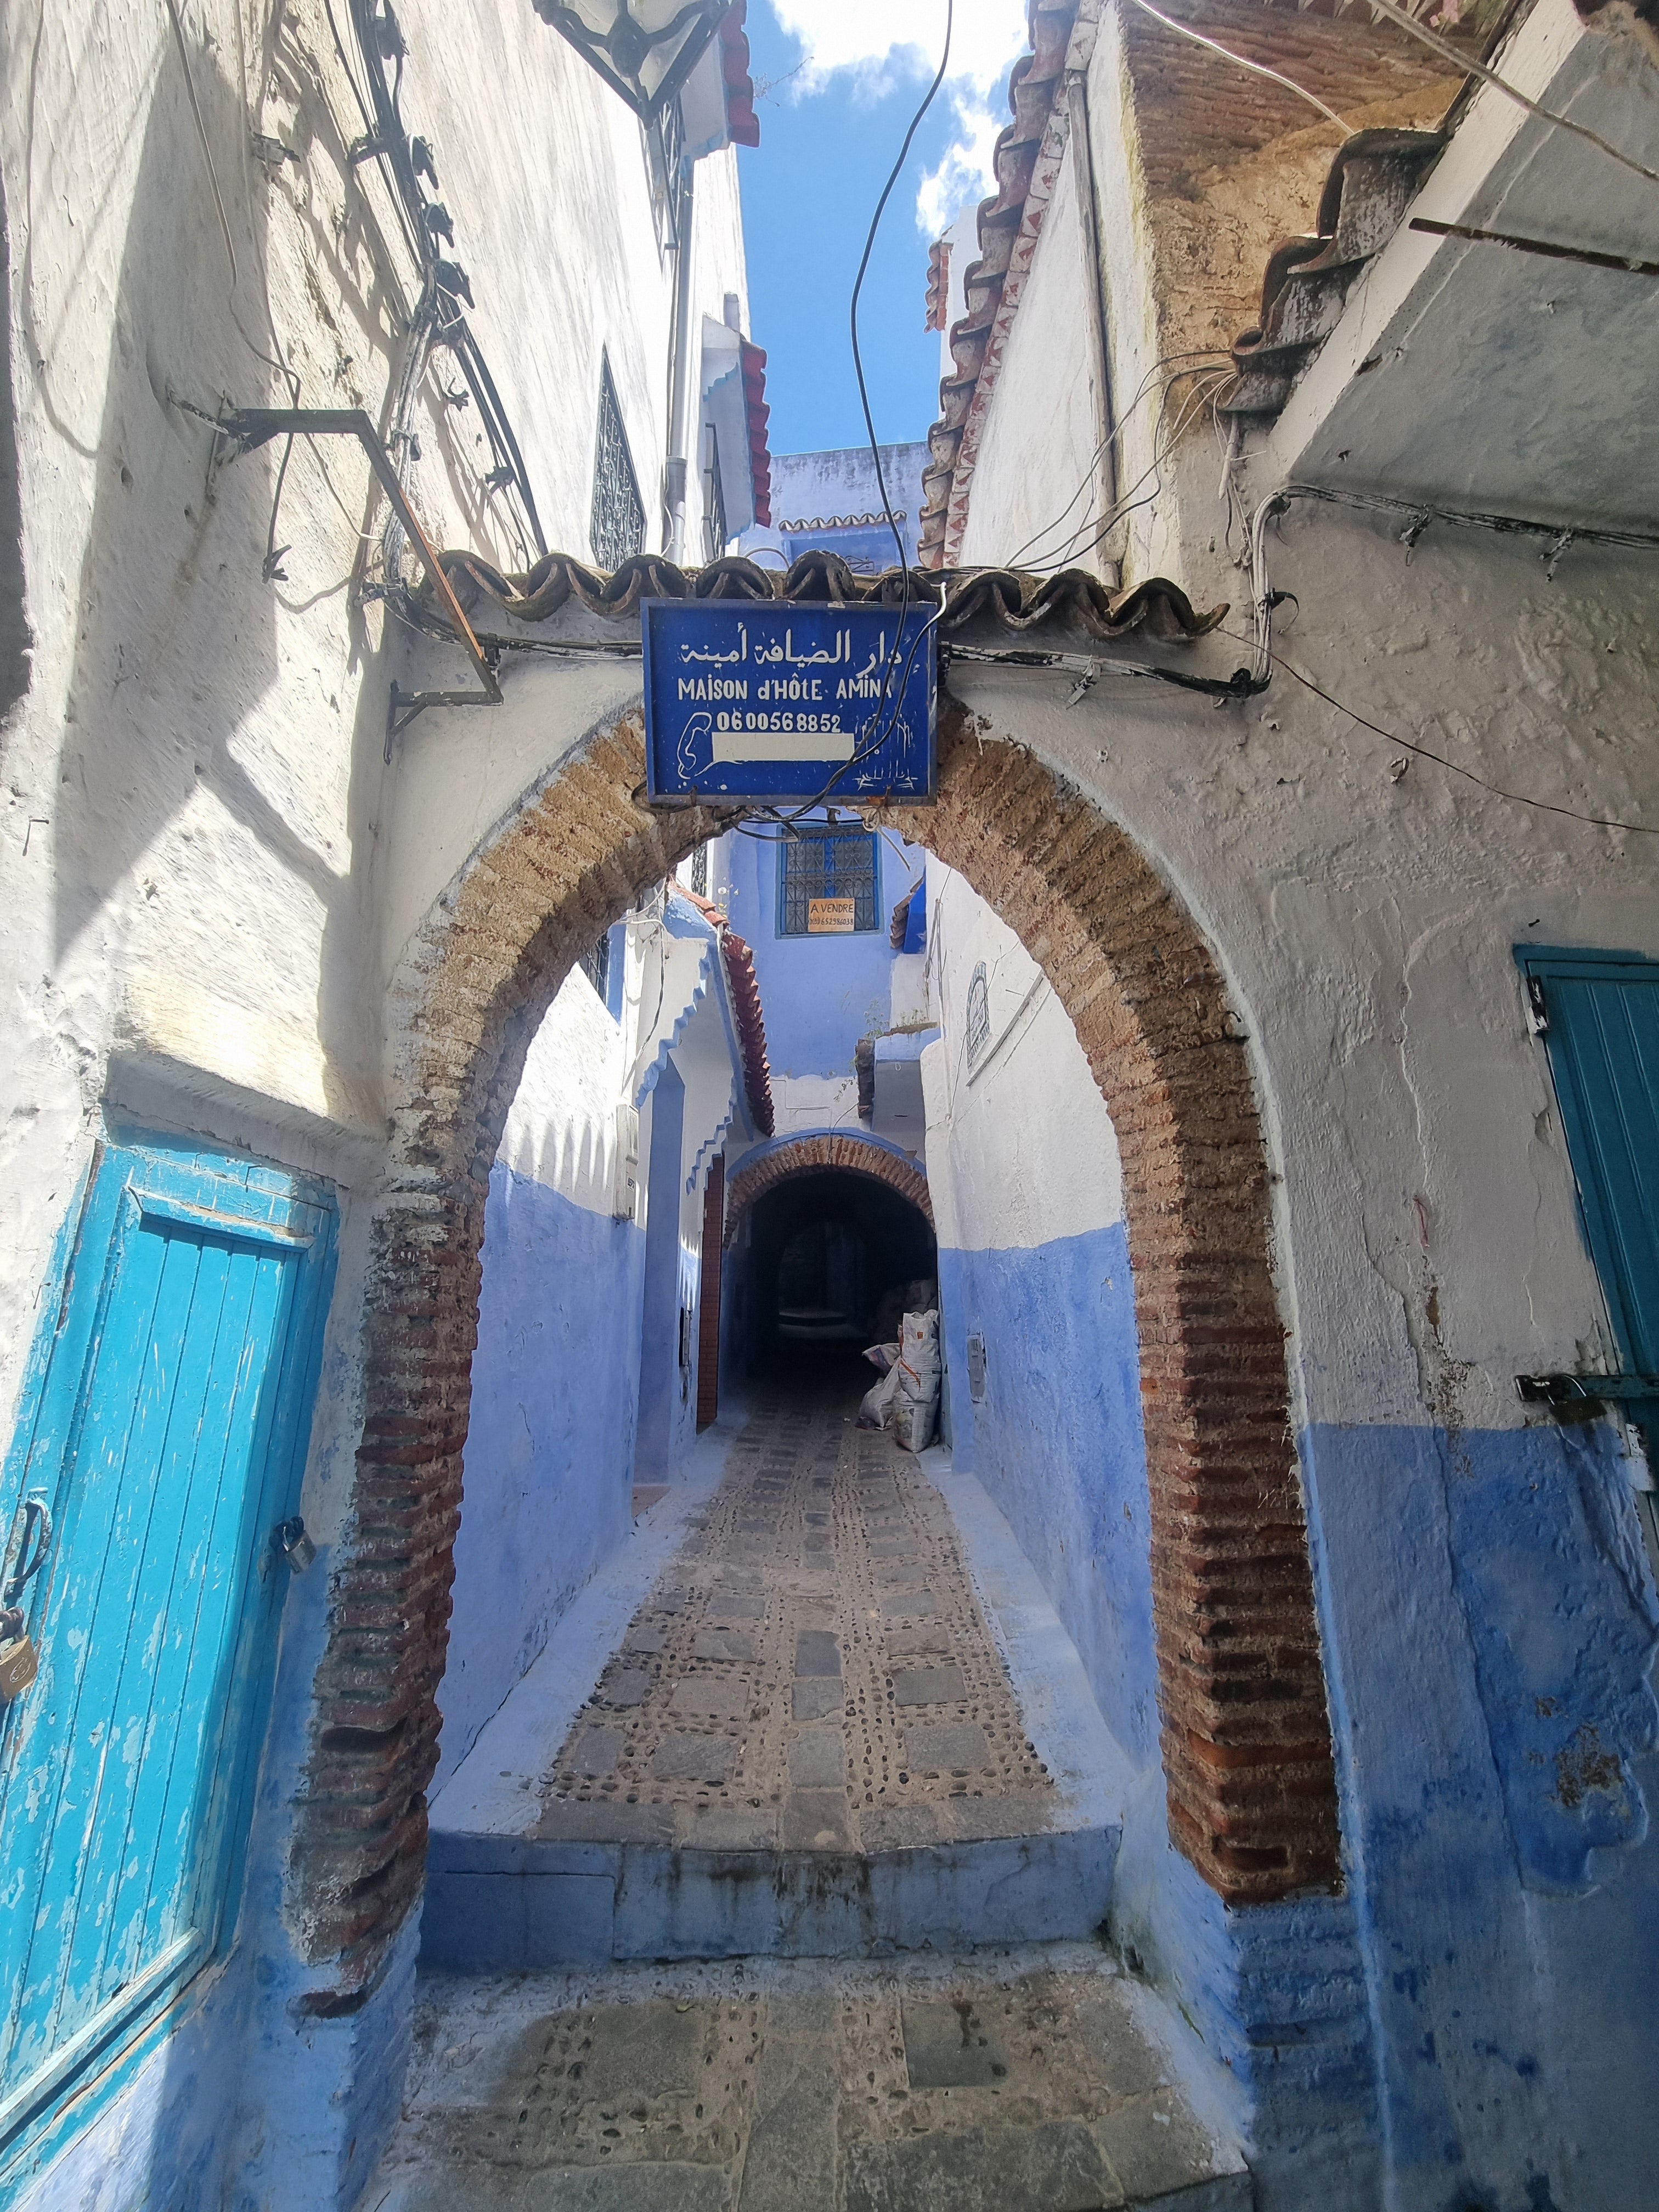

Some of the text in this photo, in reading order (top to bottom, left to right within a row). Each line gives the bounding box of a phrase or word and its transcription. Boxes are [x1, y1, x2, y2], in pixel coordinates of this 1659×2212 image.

[680, 622, 902, 679] دار الضيافة أمينة
[716, 712, 840, 733] 0600568852
[810, 904, 854, 913] A VENDRE
